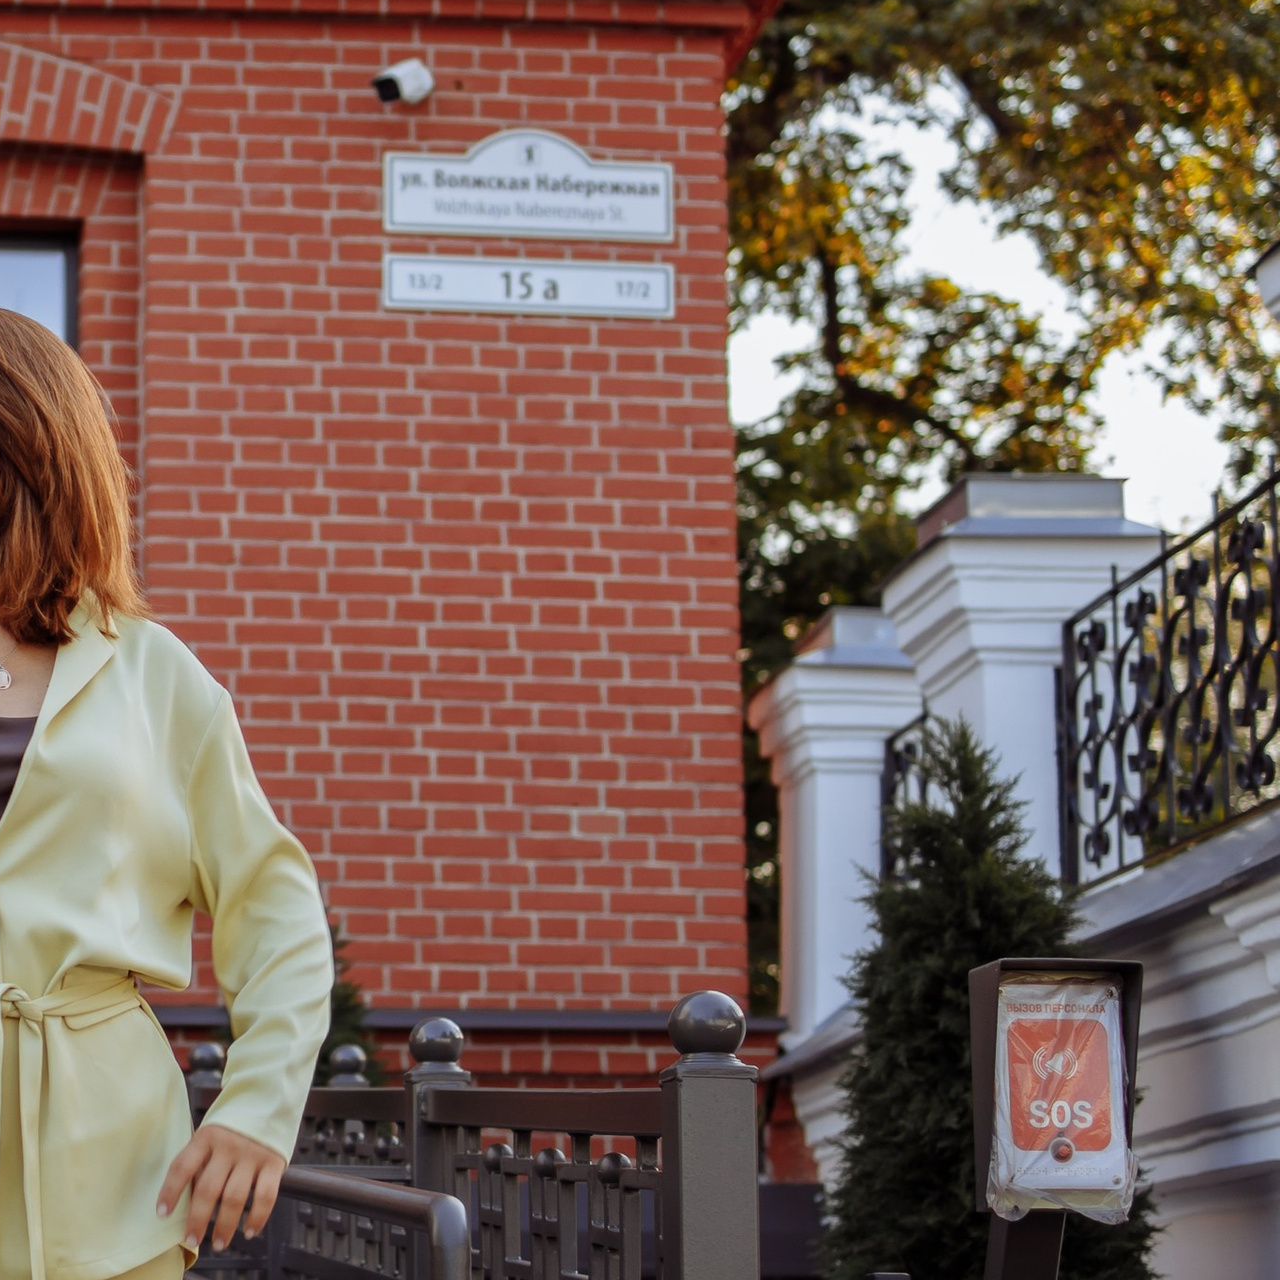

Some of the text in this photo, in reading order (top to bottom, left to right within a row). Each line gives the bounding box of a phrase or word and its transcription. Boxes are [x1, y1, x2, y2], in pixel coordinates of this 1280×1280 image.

[401, 170, 660, 197] ул. Волжская Набережная
[408, 273, 443, 290] 13/2
[500, 272, 534, 300] 15
[616, 281, 651, 298] 17/2
[1006, 1003, 1106, 1014] ВЫЗОВ ПЕРСОНАЛА
[1029, 1100, 1094, 1129] SOS
